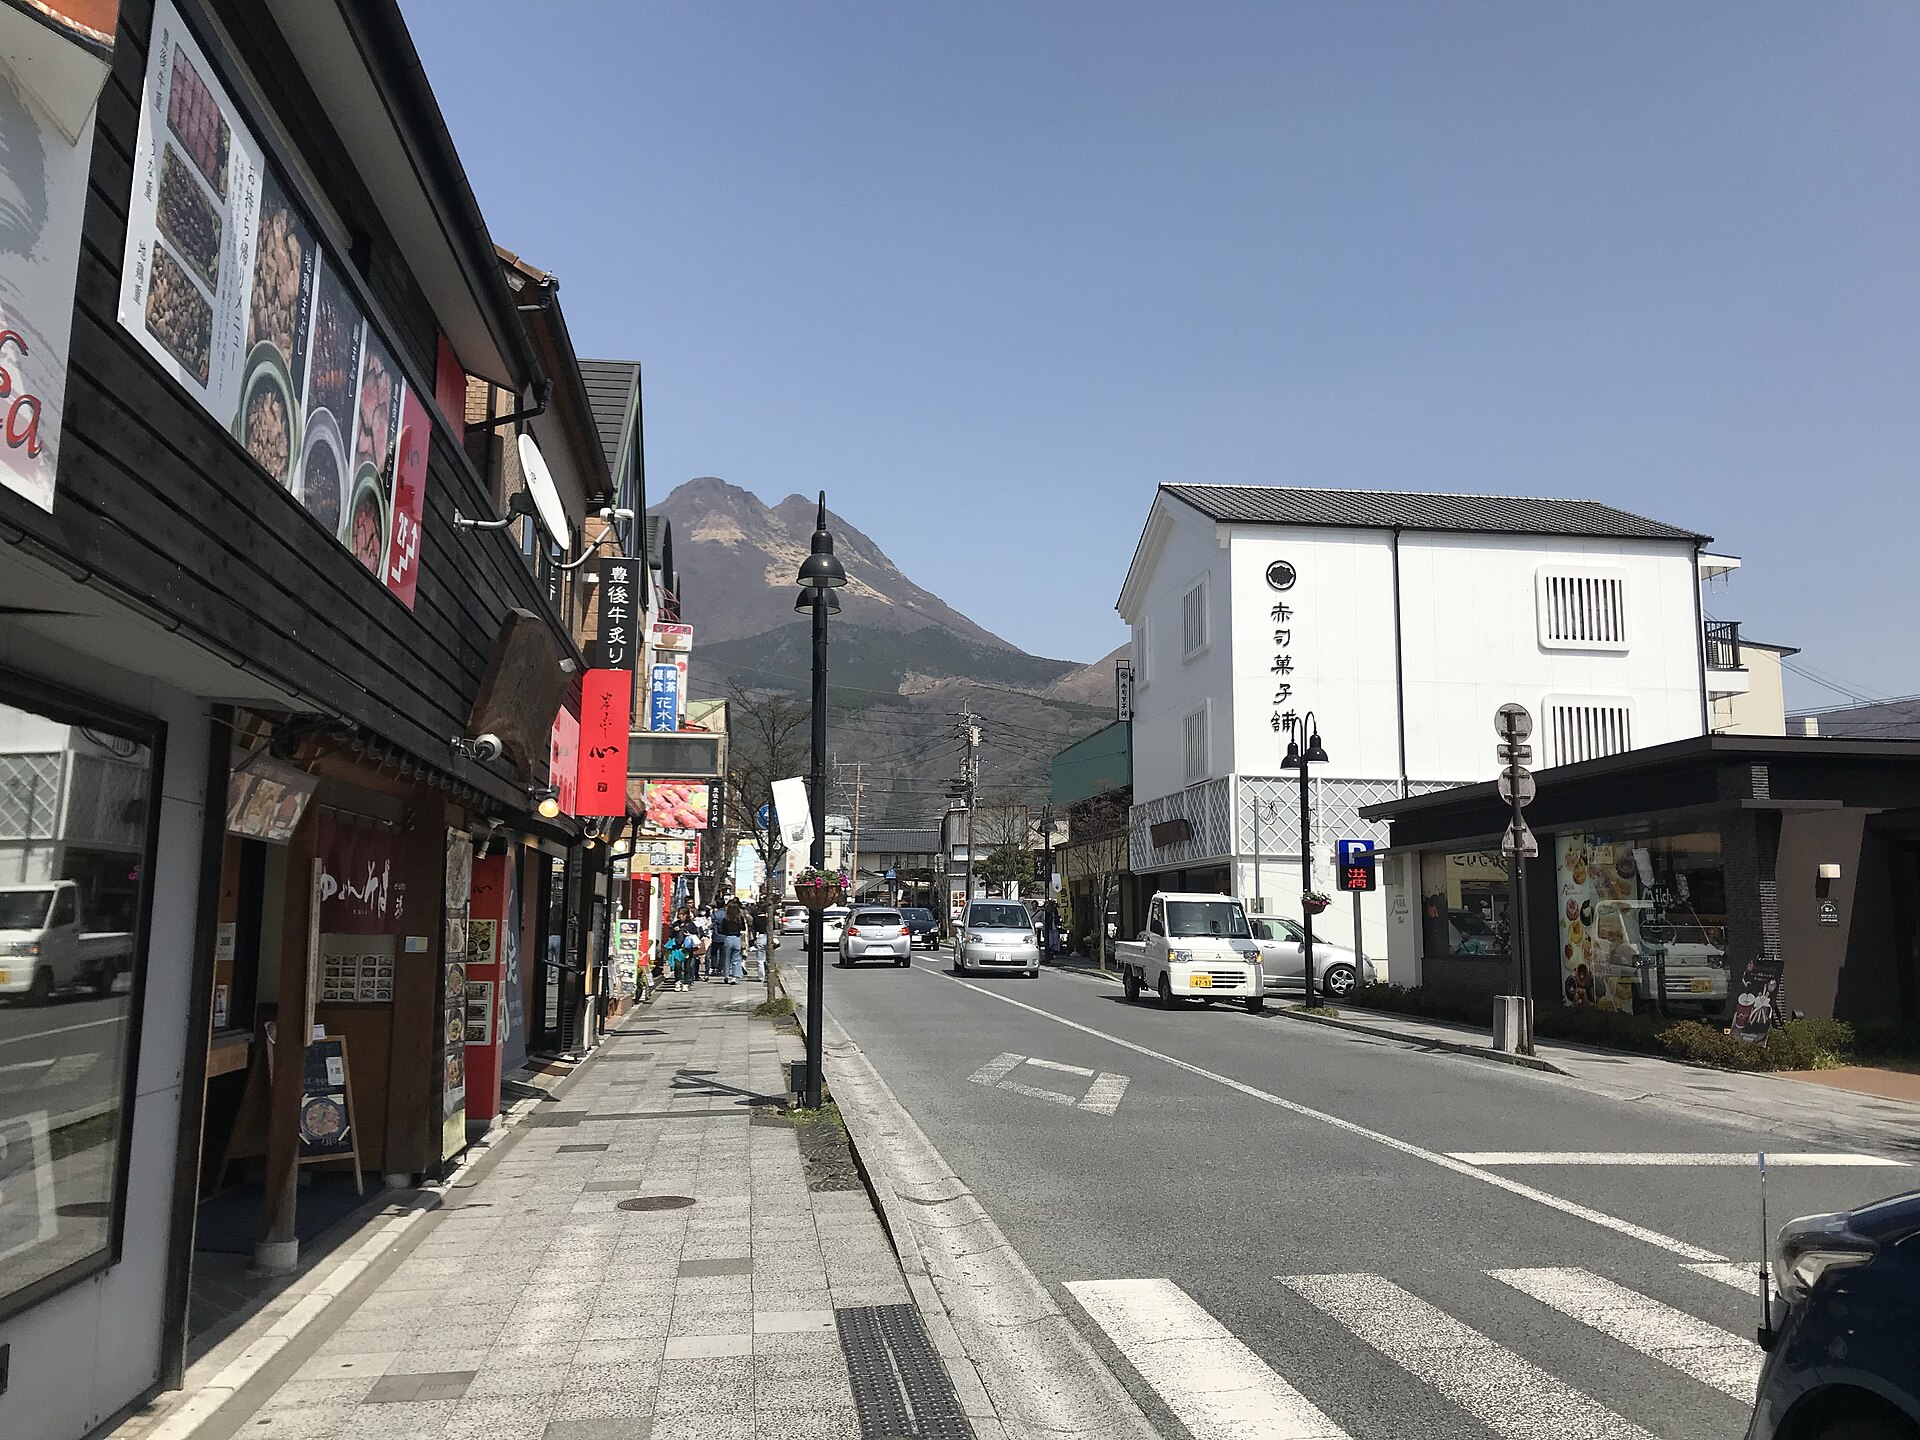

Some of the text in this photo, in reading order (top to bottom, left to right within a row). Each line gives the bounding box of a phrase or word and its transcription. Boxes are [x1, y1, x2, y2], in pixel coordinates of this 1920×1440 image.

[230, 161, 256, 370] お持ち帰りメニュー
[396, 511, 409, 549] 2F
[607, 565, 630, 671] 豊後牛炙り
[1270, 601, 1296, 733] 赤司菓子舗
[653, 669, 664, 692] 軽食
[666, 669, 677, 692] 喫茶
[655, 697, 673, 732] 花水木
[589, 745, 619, 759] 心
[650, 854, 683, 866] 喫茶
[1348, 842, 1367, 865] P
[1347, 868, 1367, 889] 満
[637, 888, 645, 917] ROLL
